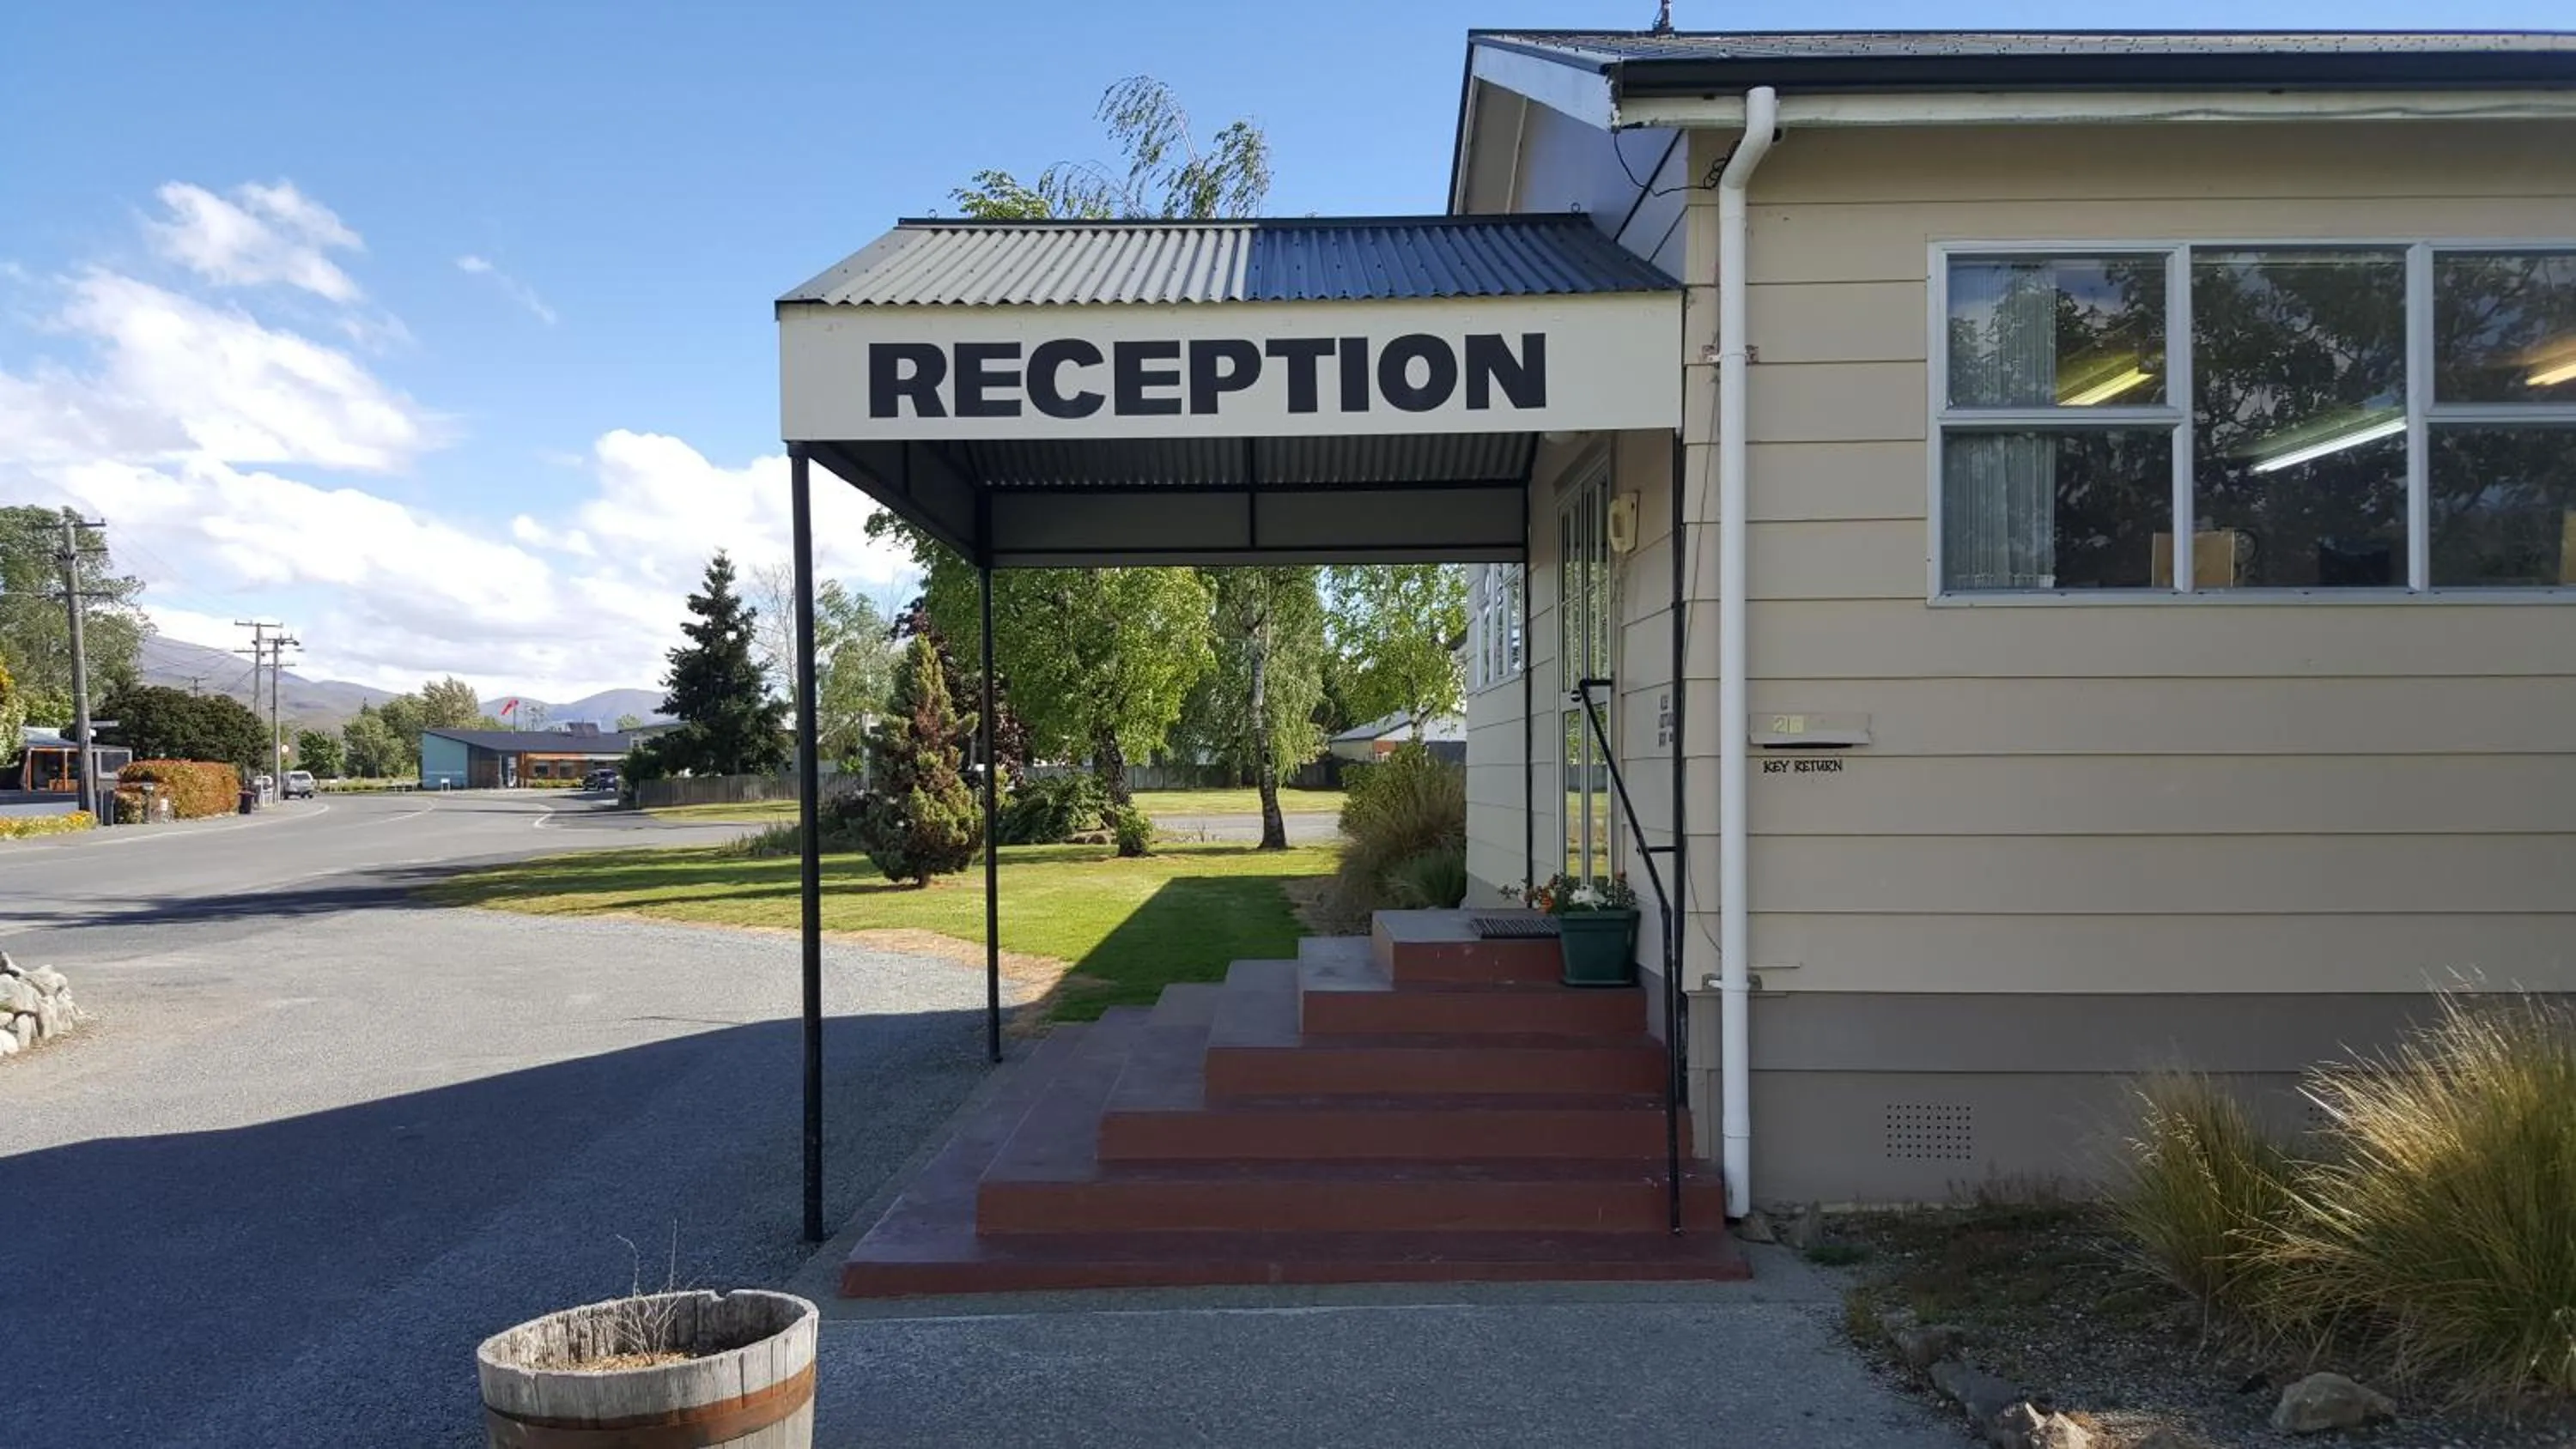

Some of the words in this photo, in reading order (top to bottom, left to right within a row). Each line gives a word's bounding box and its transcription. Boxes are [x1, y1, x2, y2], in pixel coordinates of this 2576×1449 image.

[869, 333, 1546, 419] RECEPTION
[1763, 760, 1789, 773] KEY
[1794, 760, 1843, 773] RETURN
